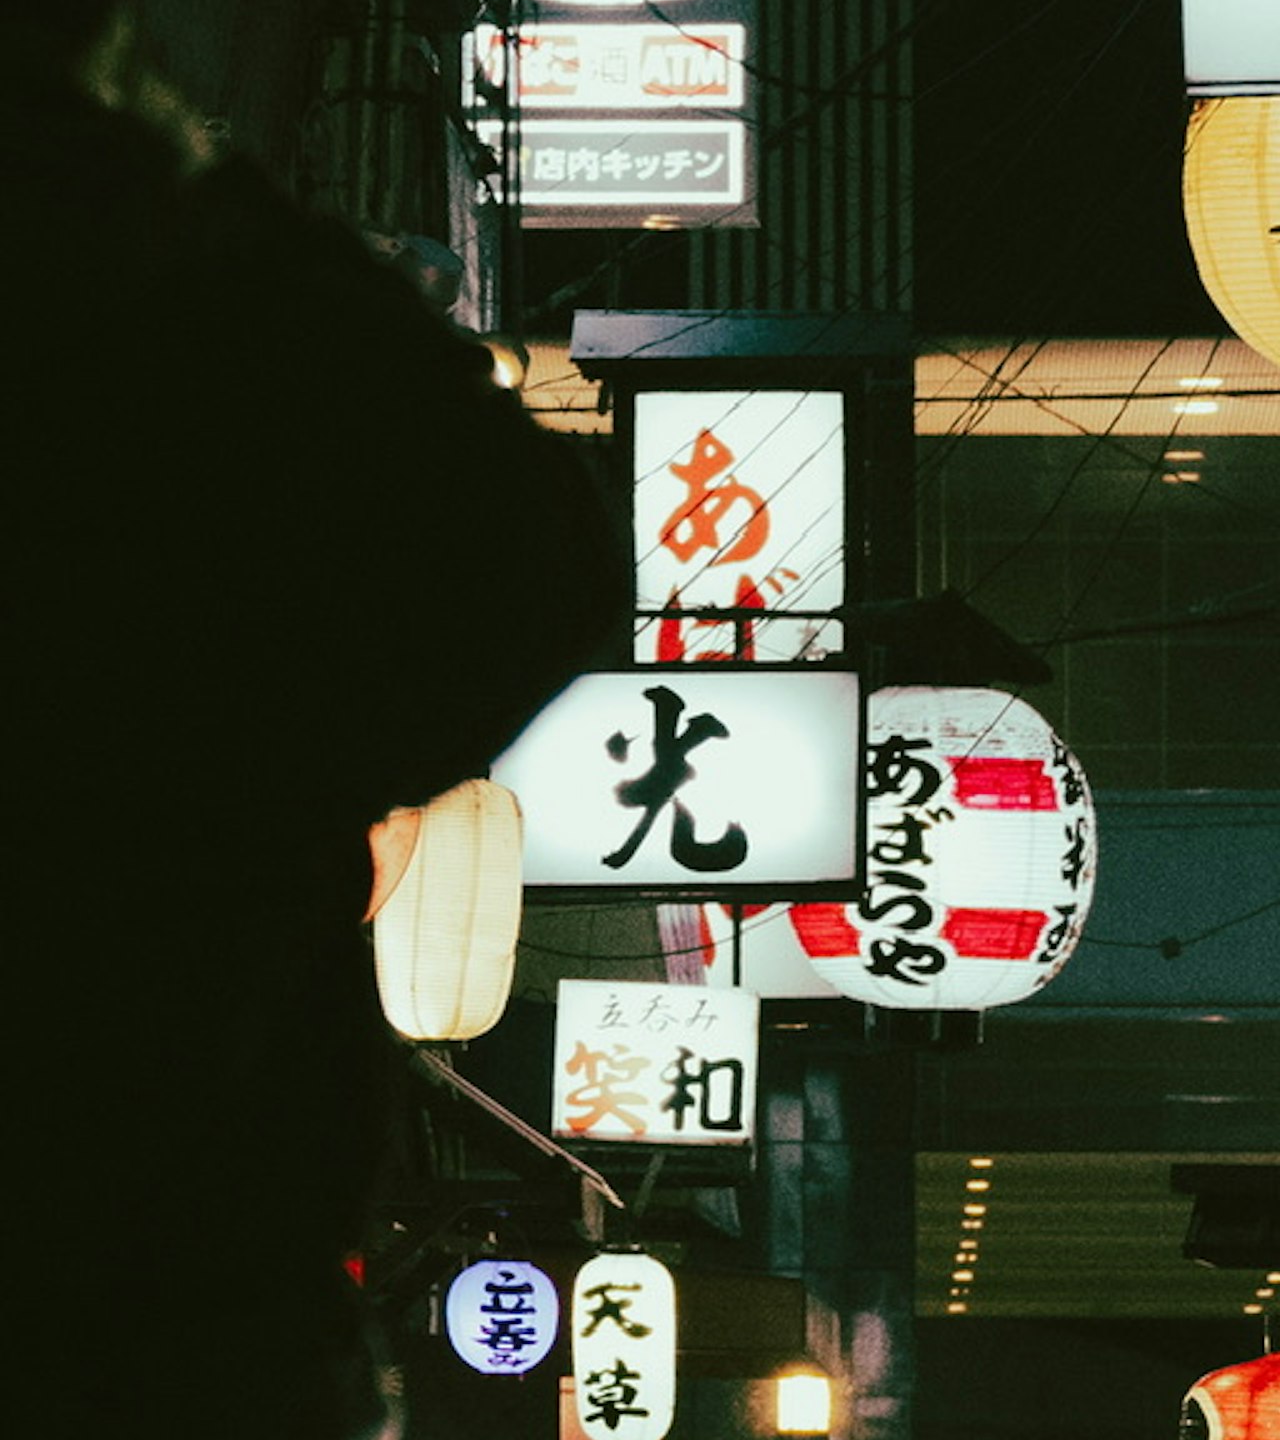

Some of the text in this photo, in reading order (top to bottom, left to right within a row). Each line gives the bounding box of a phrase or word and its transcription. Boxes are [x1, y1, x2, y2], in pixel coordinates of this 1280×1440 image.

[639, 43, 728, 86] ATM
[533, 147, 725, 182] 店内キッチン
[601, 684, 750, 873] 光
[596, 994, 720, 1032] 立呑み
[564, 1041, 744, 1136] 笑和
[581, 1282, 652, 1430] 天草
